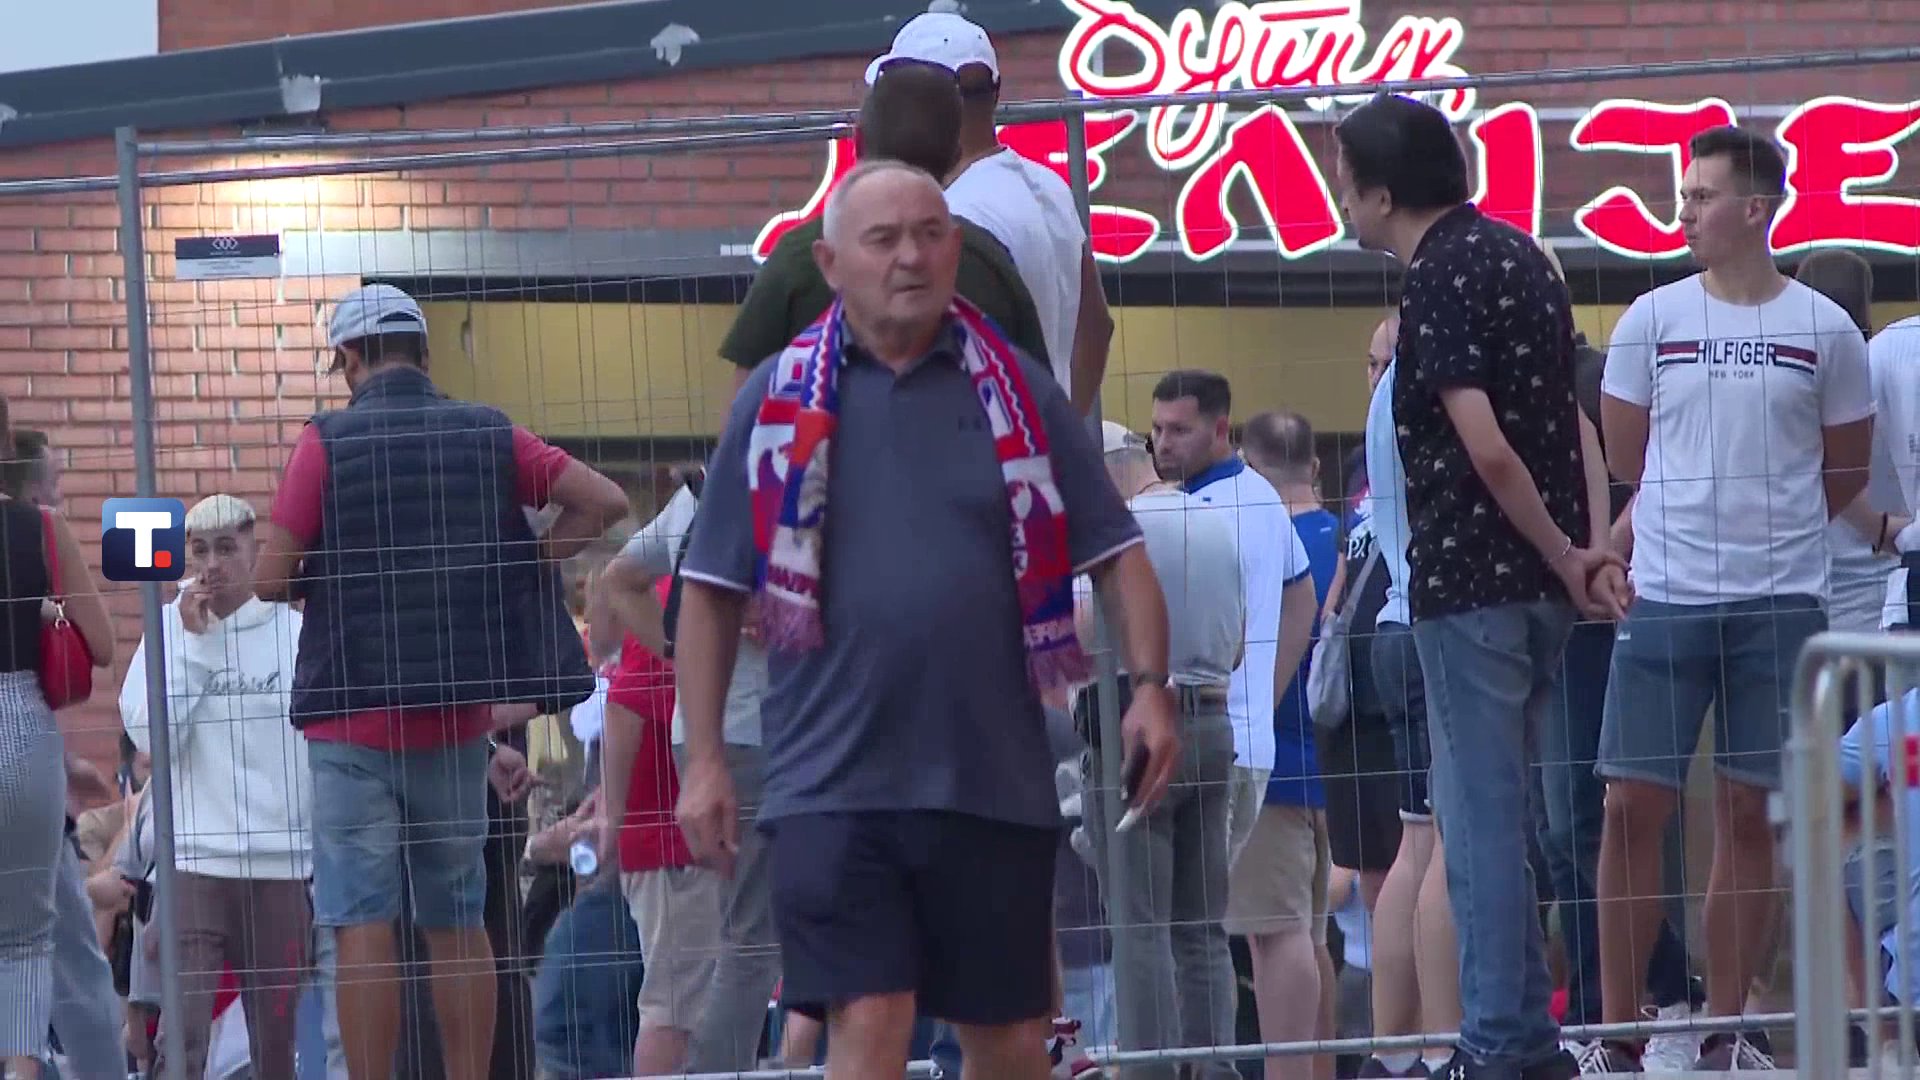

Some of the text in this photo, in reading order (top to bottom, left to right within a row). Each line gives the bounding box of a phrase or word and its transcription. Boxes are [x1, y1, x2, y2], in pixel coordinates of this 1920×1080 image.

[1696, 341, 1777, 366] HILFIGER
[1709, 368, 1755, 379] NEW YORK
